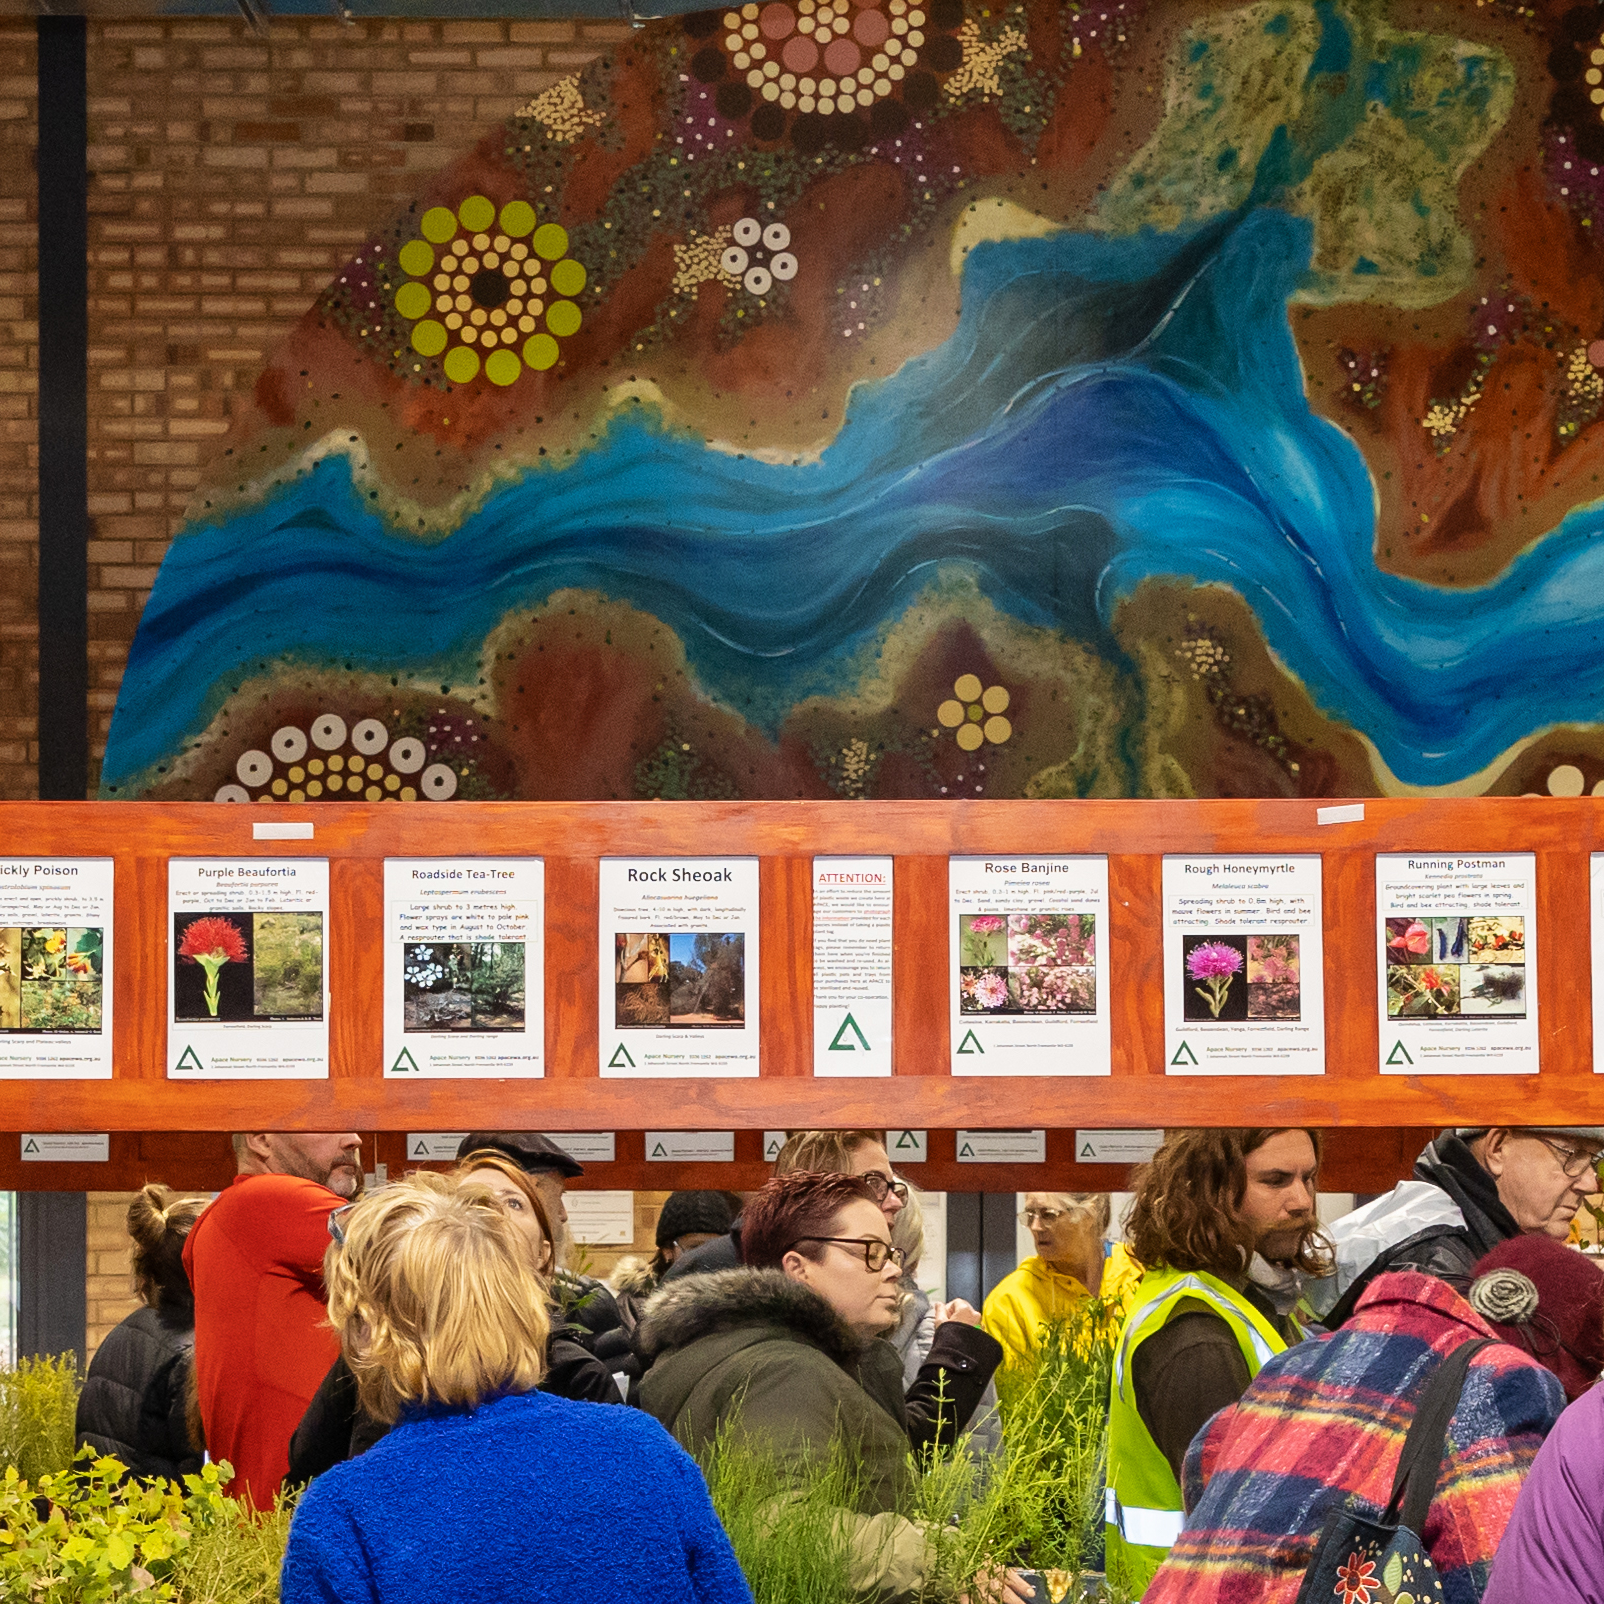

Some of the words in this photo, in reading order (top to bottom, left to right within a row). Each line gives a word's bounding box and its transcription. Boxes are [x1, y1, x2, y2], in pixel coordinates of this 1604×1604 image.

[34, 865, 78, 876] Poison
[985, 862, 1017, 873] Rose
[1021, 862, 1069, 875] Banjine
[1184, 864, 1220, 876] Rough
[1223, 863, 1296, 875] Honeymyrtle
[1407, 859, 1454, 871] Running
[1457, 859, 1506, 869] Postman
[198, 867, 234, 879] Purple
[237, 867, 297, 877] Beaufortia
[412, 869, 463, 879] Roadside
[466, 869, 515, 879] Tea-Tree
[628, 868, 667, 882] Rock
[672, 867, 733, 882] Sheoak
[818, 873, 886, 883] ATTENTION:
